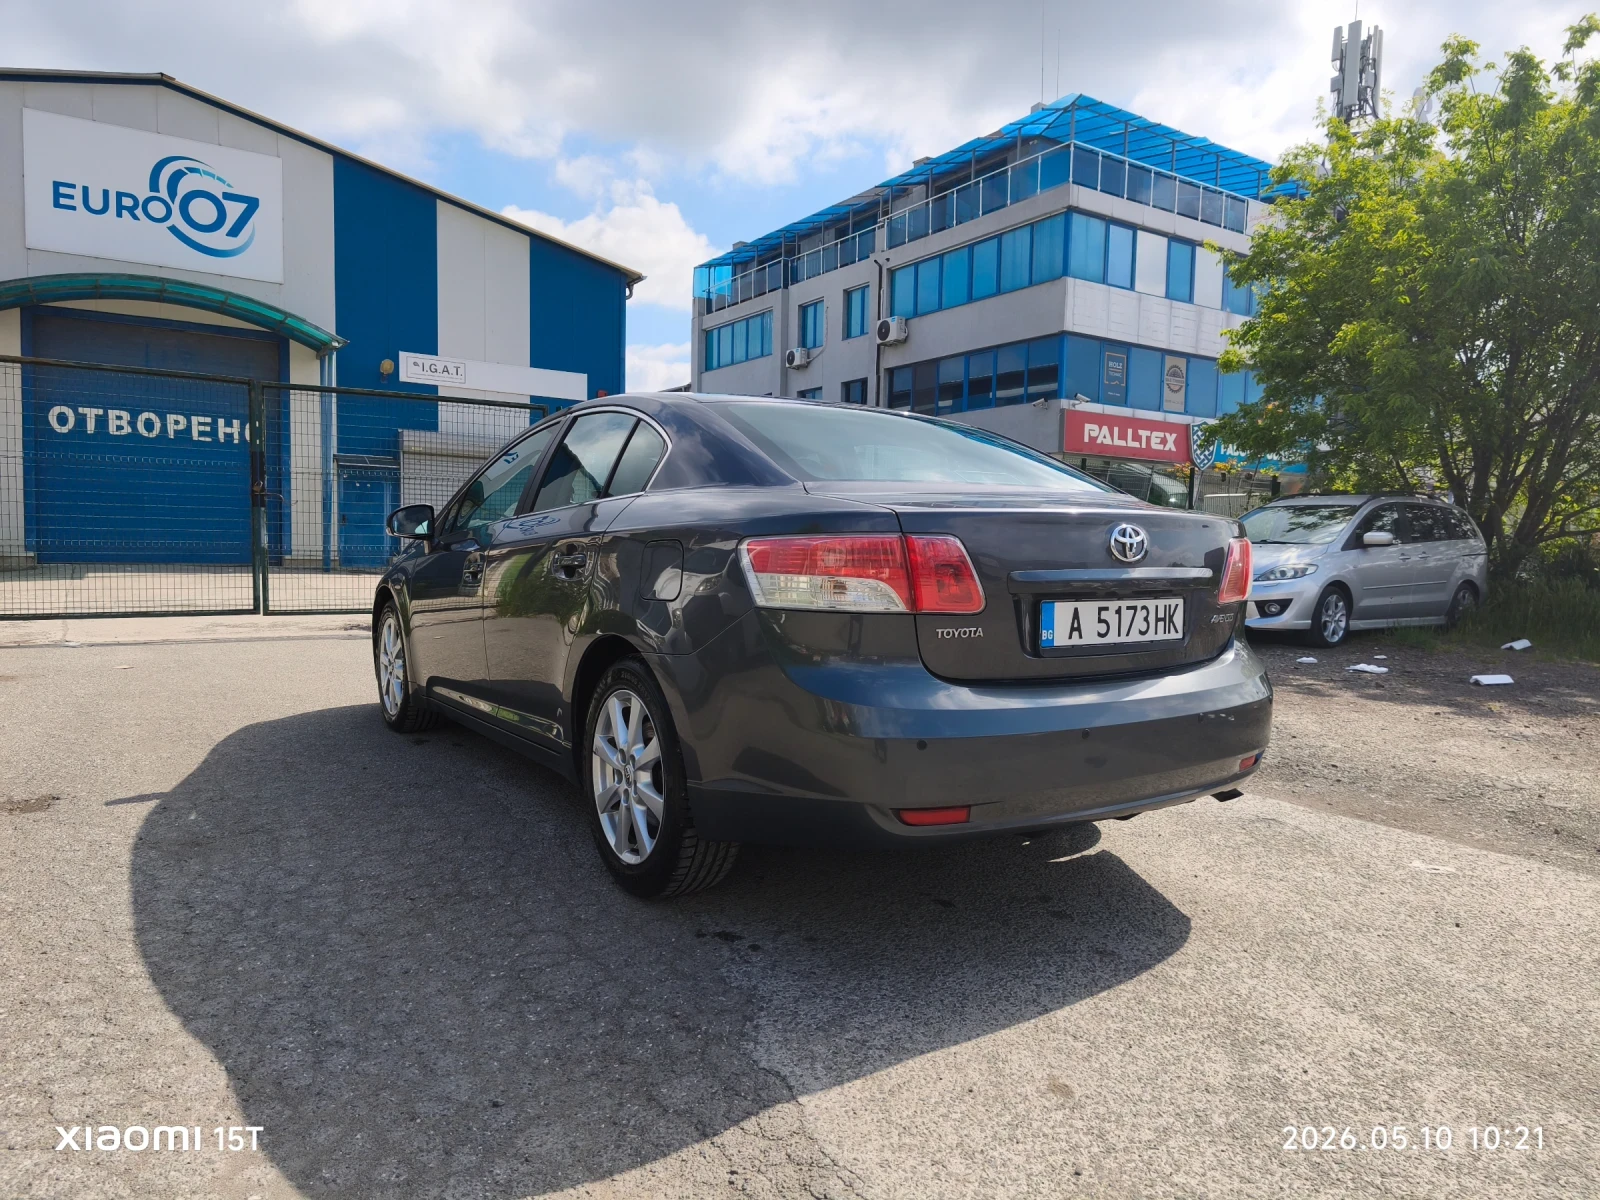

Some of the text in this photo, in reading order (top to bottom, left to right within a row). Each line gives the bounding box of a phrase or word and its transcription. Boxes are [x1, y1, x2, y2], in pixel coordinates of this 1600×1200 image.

[52, 180, 173, 224] EURO
[421, 362, 463, 376] I.G.A.T.
[48, 405, 251, 444] ОТВОРЕН
[1083, 423, 1178, 452] PALLTEX
[935, 627, 984, 639] TOYOTA
[1042, 630, 1053, 640] BG
[1068, 607, 1083, 639] A
